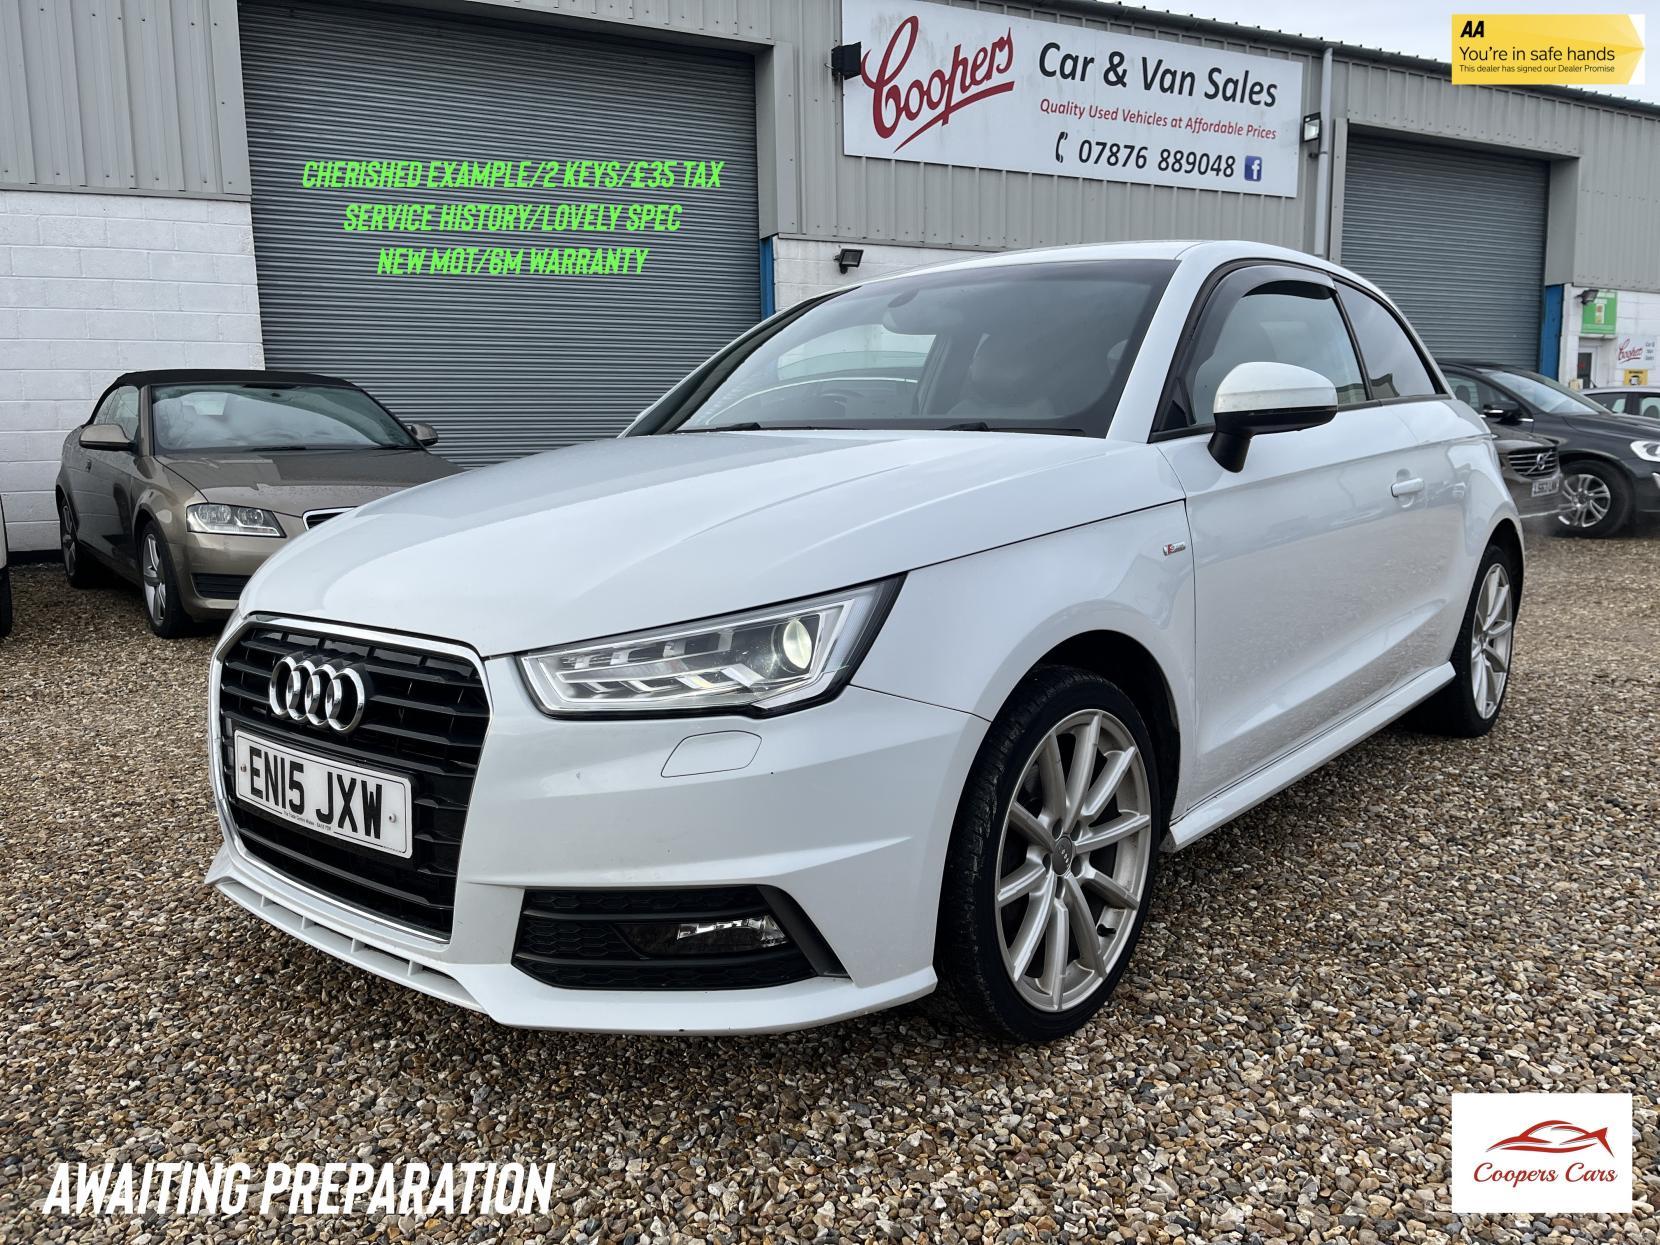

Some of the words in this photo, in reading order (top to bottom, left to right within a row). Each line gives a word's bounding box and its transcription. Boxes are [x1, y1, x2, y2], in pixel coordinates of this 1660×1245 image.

[861, 15, 1014, 140] Coopers
[1038, 42, 1095, 82] Car
[1103, 50, 1128, 88] &
[1141, 56, 1196, 97] Van
[1203, 67, 1278, 108] Sales
[1039, 98, 1086, 120] Quality
[1088, 104, 1118, 121] Used
[1122, 108, 1168, 127] Vehicles
[1170, 117, 1183, 129] at
[1185, 117, 1244, 136] Affordable
[1246, 124, 1277, 140] Prices
[1078, 139, 1149, 170] 07876
[1157, 147, 1236, 178] 889048
[248, 744, 305, 817] EN15
[314, 770, 383, 840] JXW
